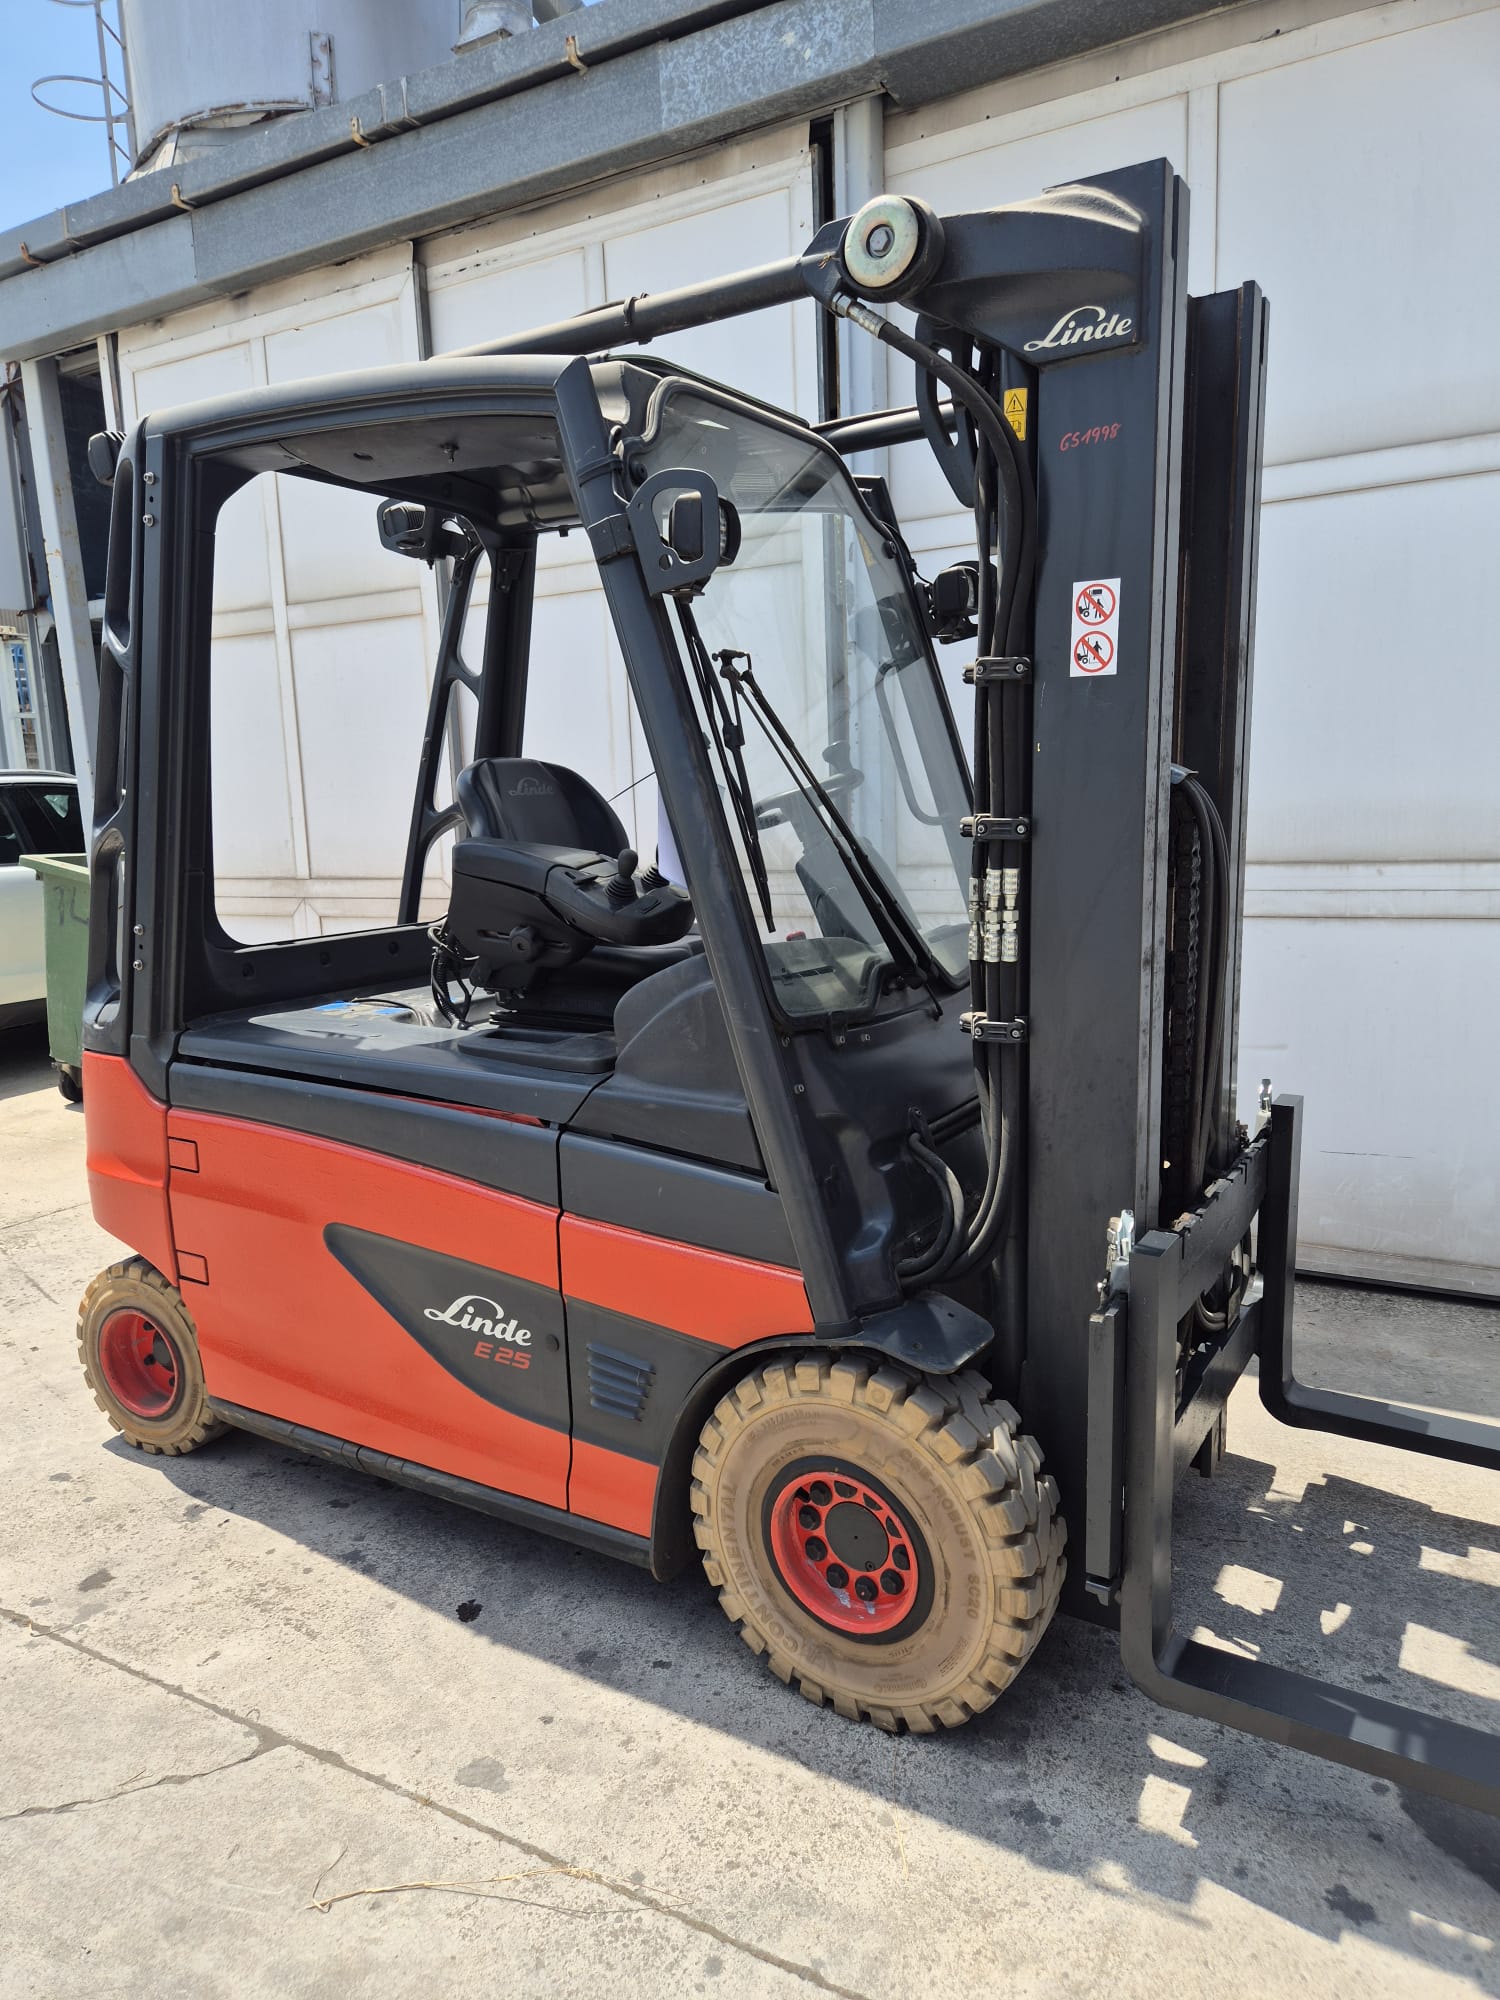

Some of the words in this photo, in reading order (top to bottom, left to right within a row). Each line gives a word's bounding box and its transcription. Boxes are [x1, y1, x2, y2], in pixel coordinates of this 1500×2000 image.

[1023, 305, 1132, 352] Linde
[508, 777, 555, 796] Linde
[423, 1295, 532, 1346] Linde
[473, 1341, 494, 1359] E
[494, 1347, 532, 1370] 25
[719, 1483, 800, 1653] CONTINENTAL
[965, 1572, 982, 1620] SC20
